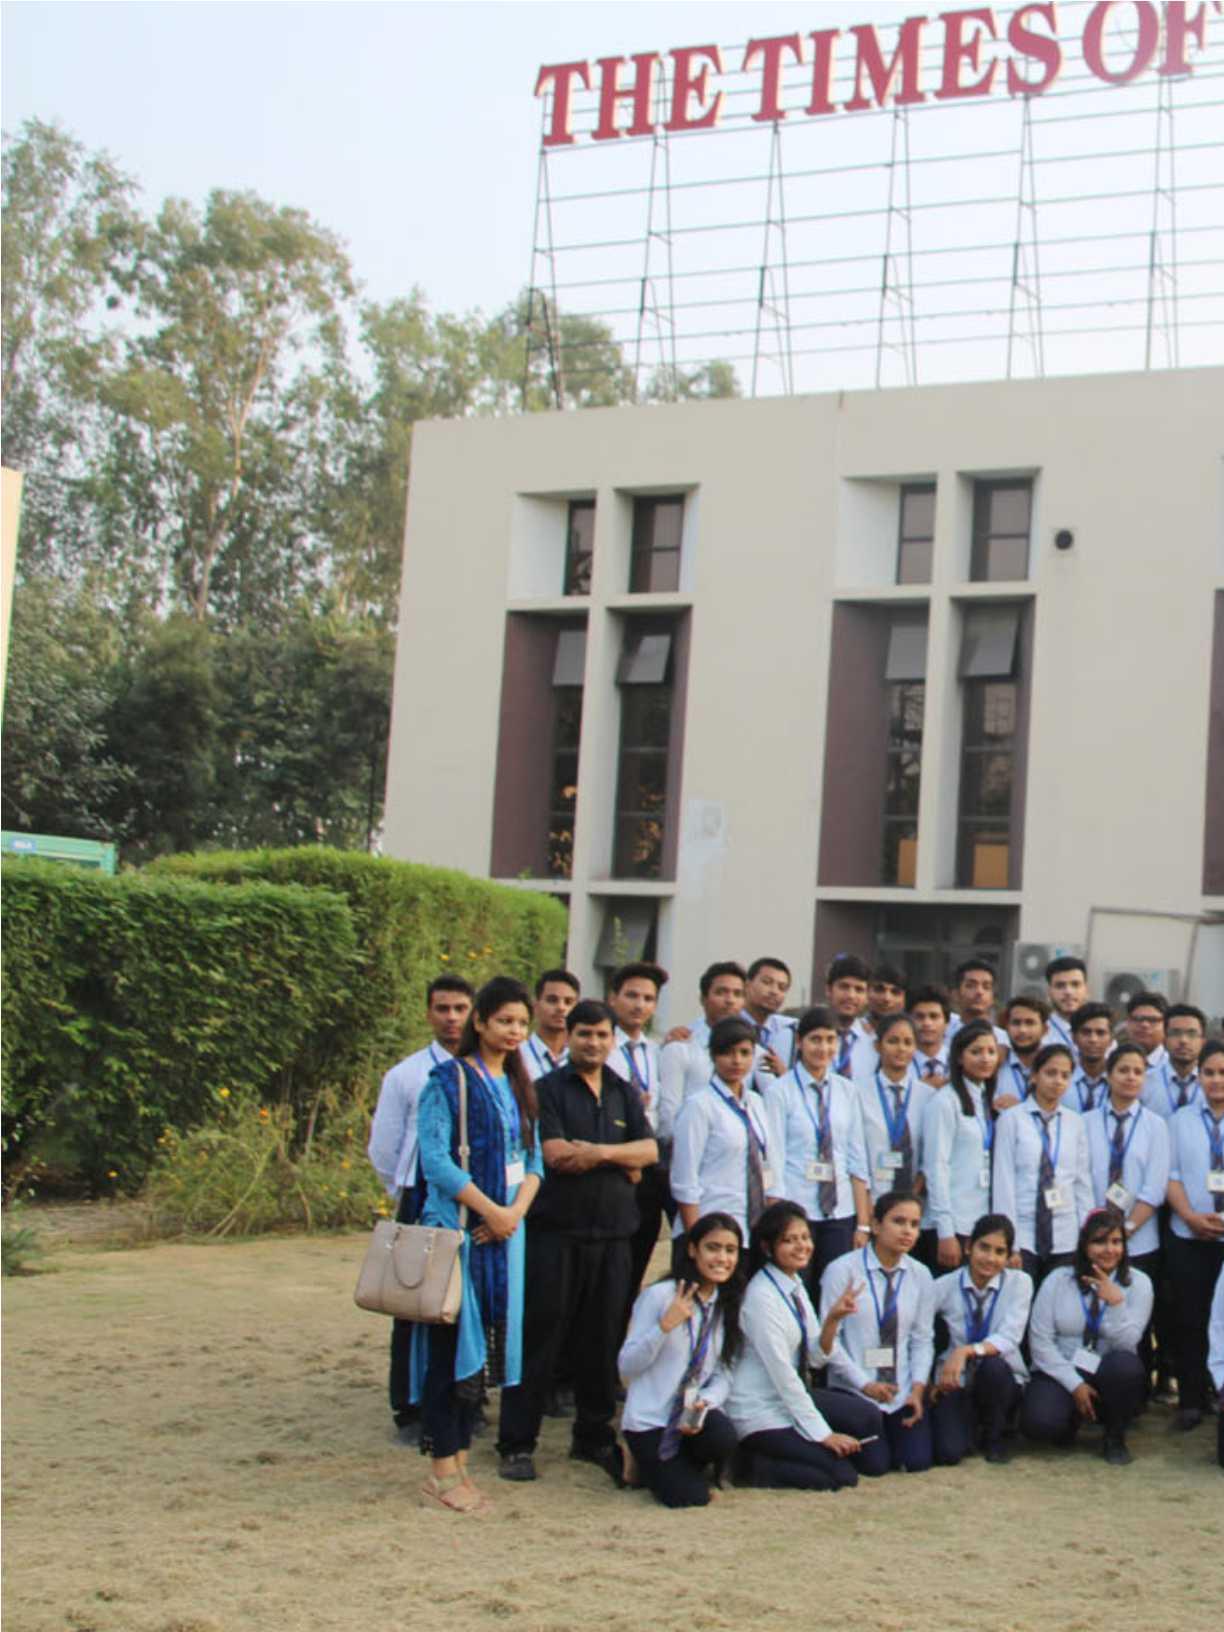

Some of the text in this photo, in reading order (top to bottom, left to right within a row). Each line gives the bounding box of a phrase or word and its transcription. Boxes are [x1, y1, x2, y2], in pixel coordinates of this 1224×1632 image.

[534, 45, 722, 146] THE
[740, 4, 1062, 121] TIMES
[1082, 1, 1222, 84] OF
